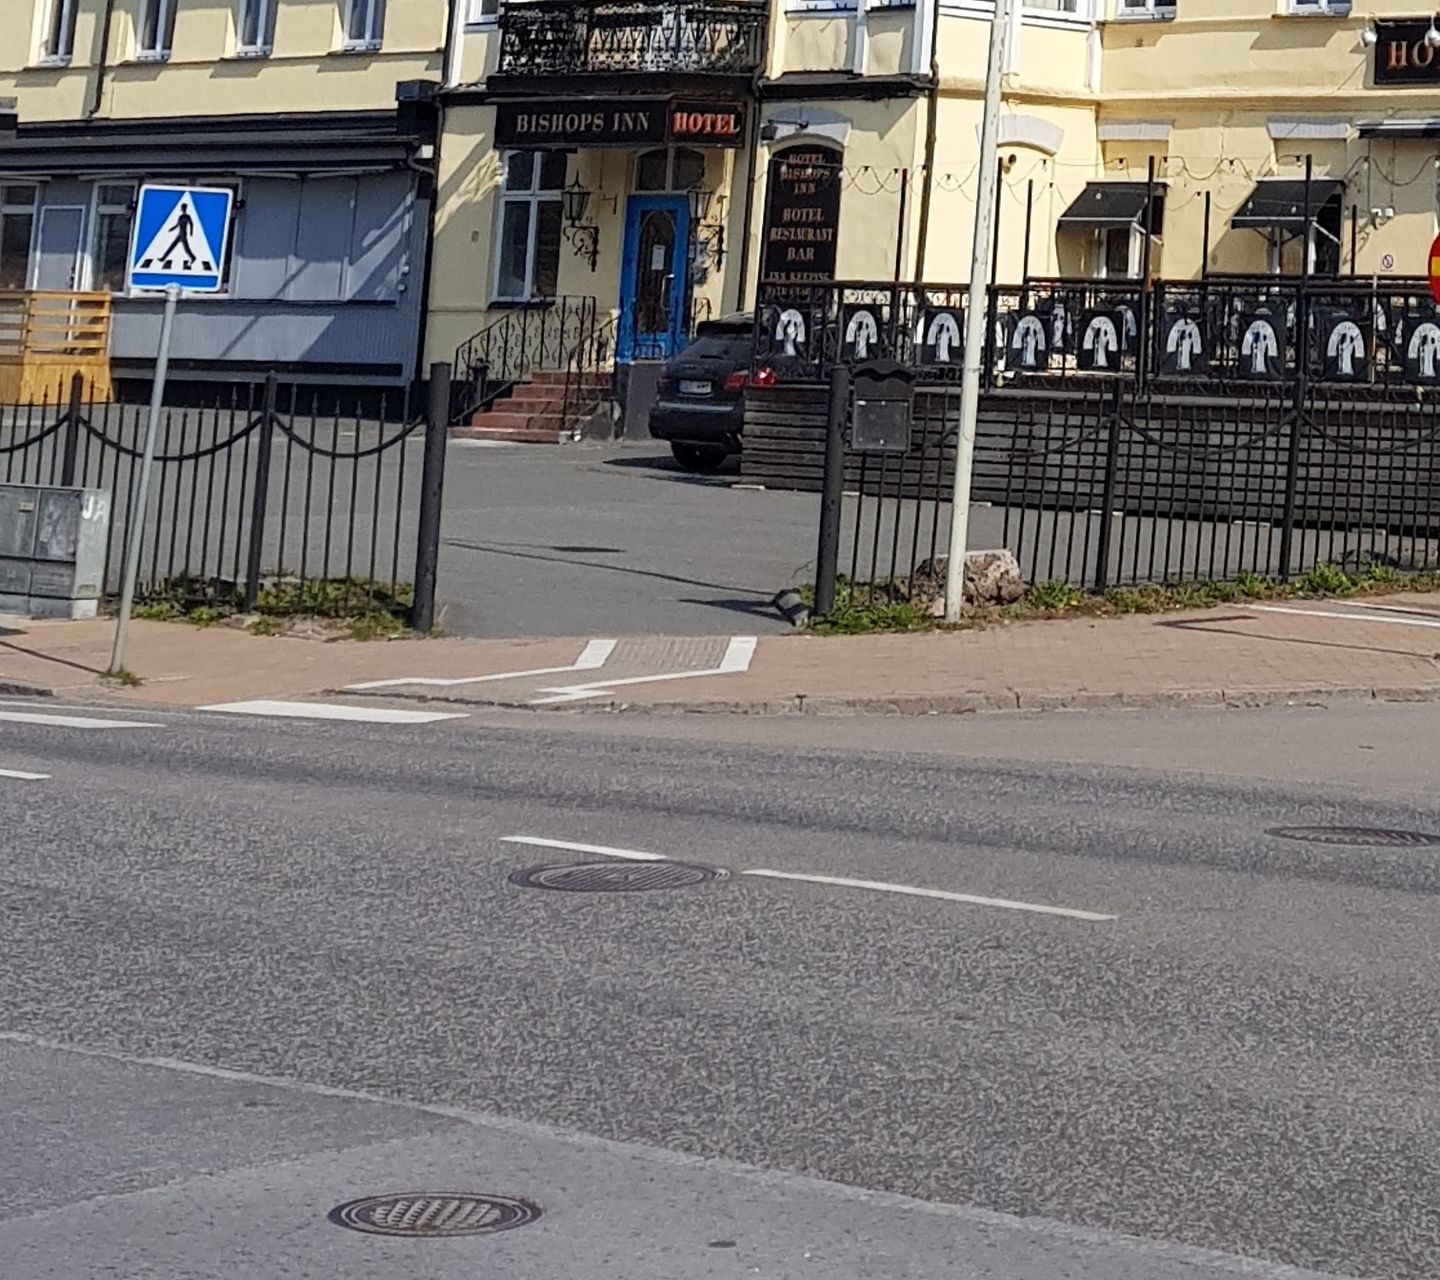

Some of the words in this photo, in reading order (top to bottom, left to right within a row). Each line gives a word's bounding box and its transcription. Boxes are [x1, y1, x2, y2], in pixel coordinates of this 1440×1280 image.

[515, 112, 605, 133] BISHOPS
[612, 111, 651, 132] INN
[671, 111, 741, 134] HOTEL
[788, 153, 825, 165] HOTEL
[793, 182, 817, 194] INN
[782, 207, 825, 222] HOTEL
[769, 227, 834, 241] RESTAURANT
[786, 246, 815, 261] BAR
